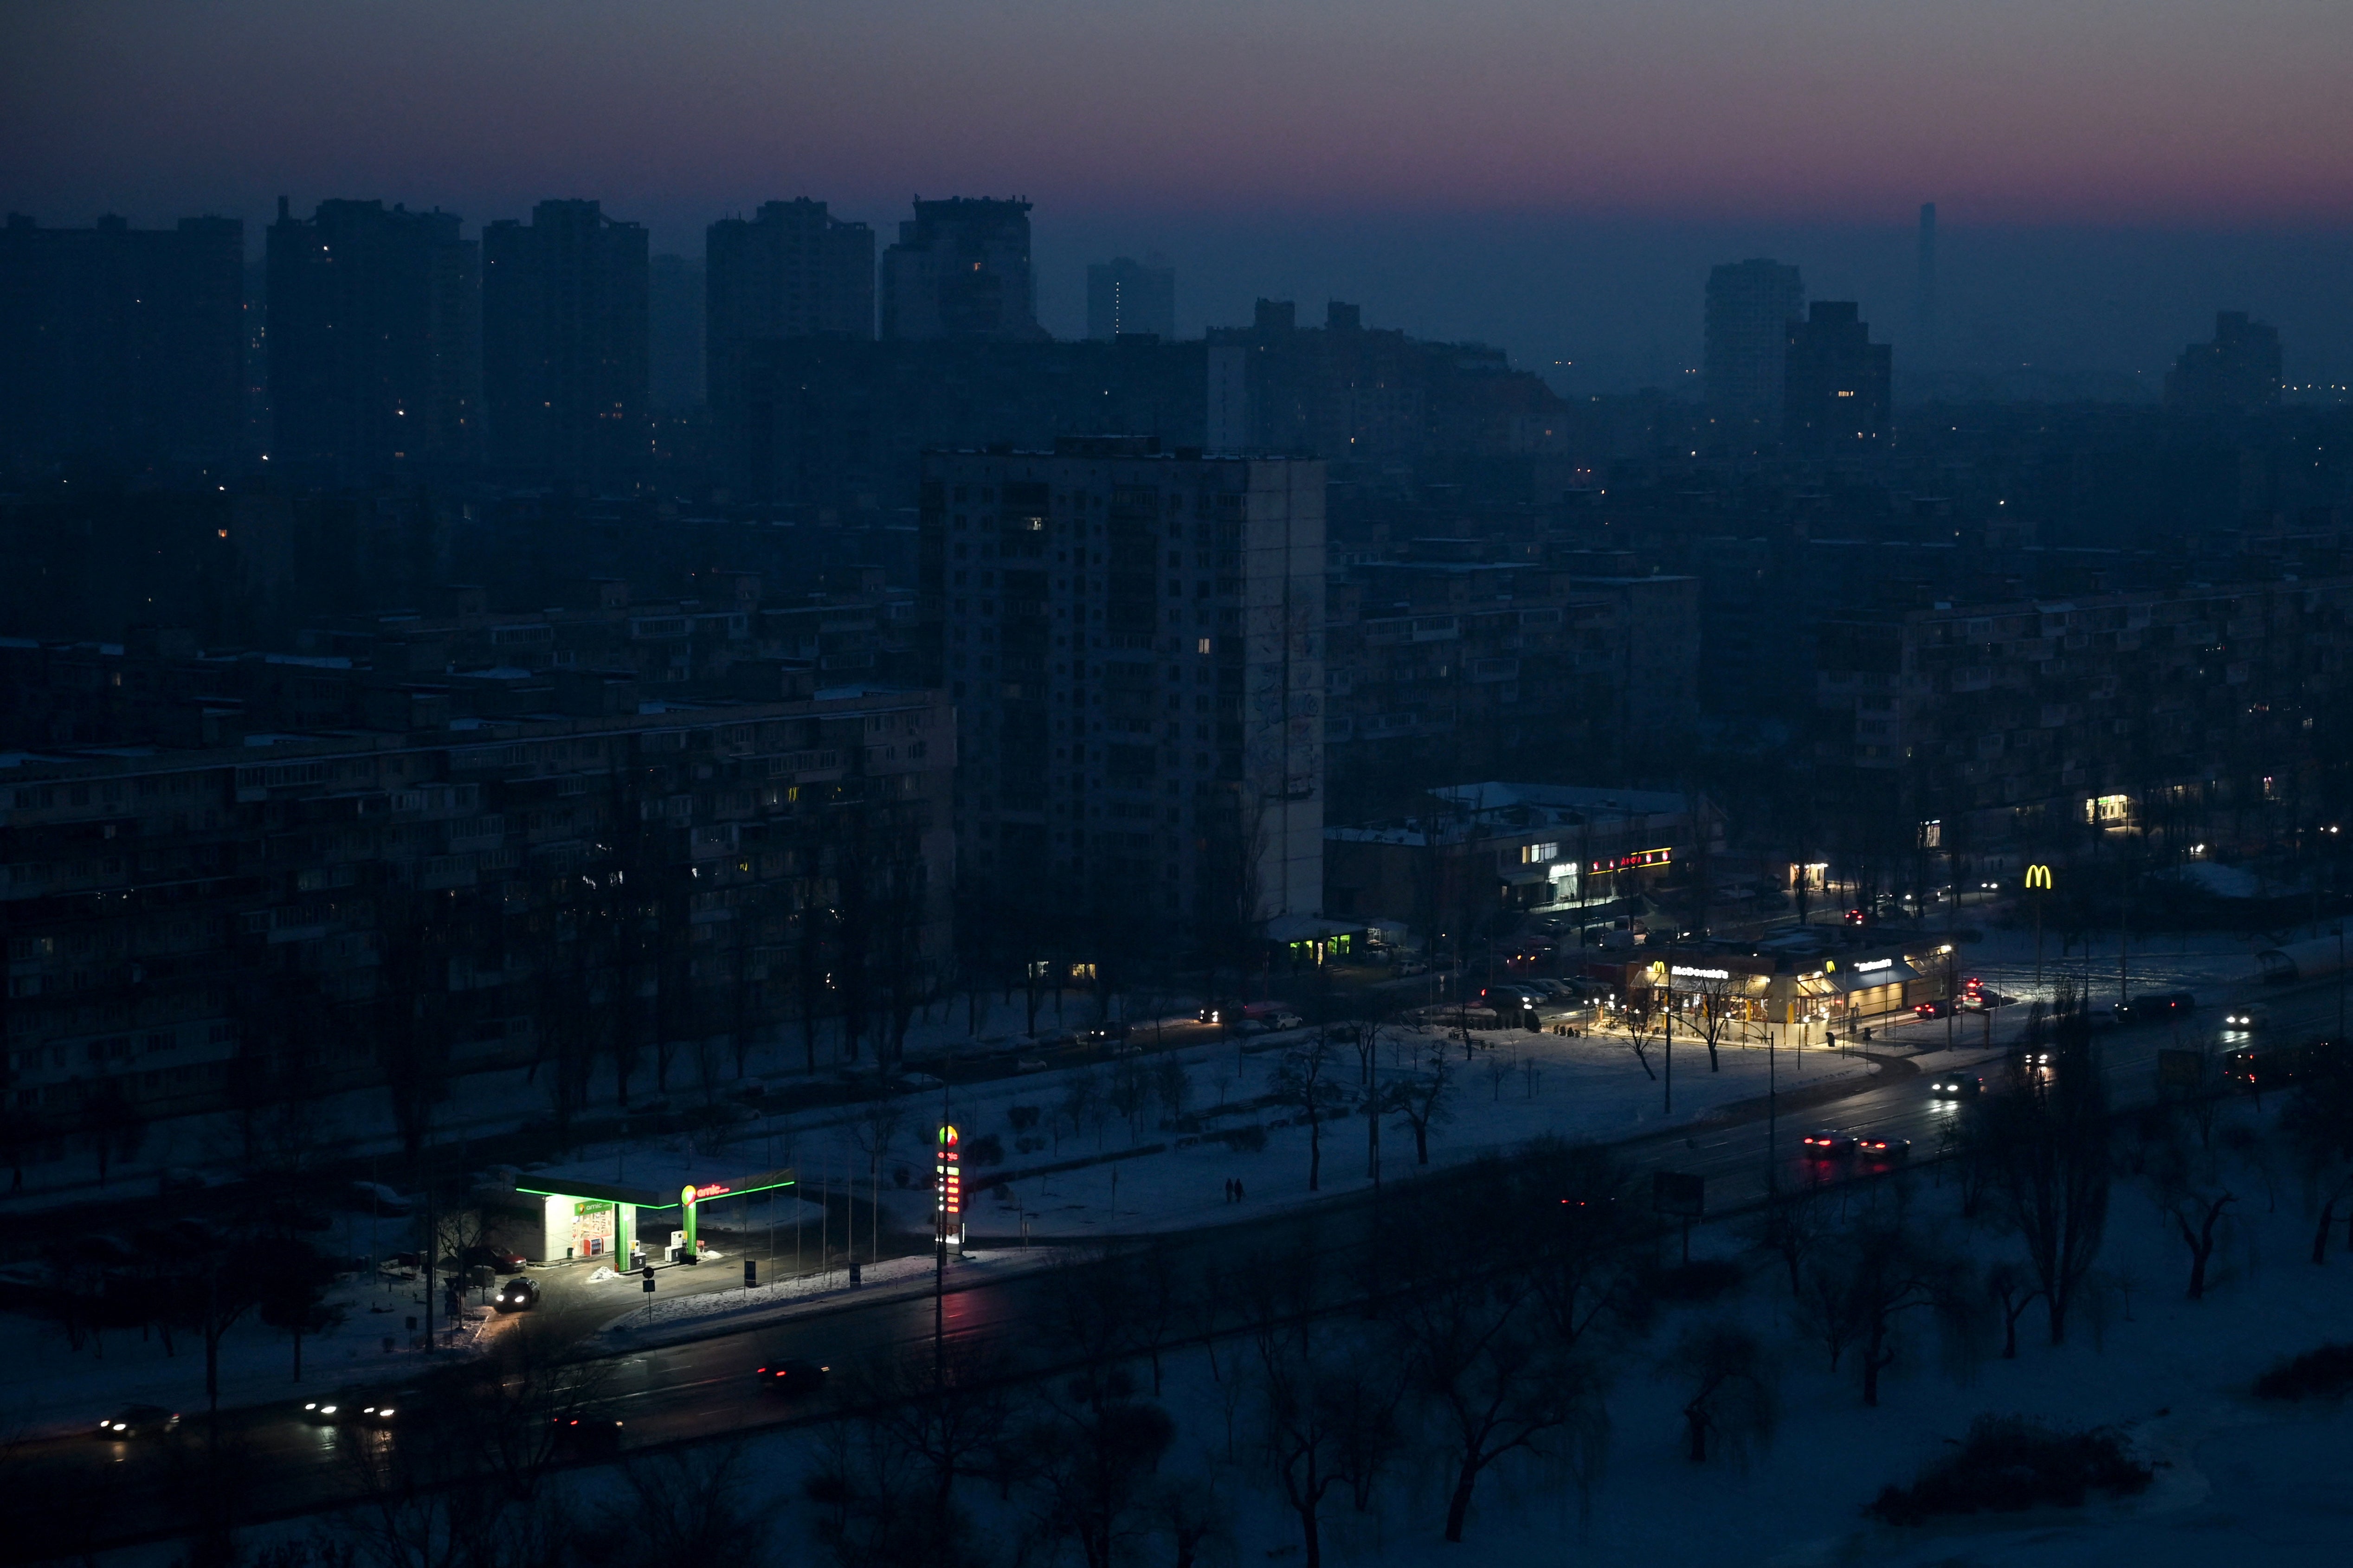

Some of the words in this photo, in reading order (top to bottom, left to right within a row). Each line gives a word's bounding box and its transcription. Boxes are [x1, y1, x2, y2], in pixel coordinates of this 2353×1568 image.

[2026, 864, 2051, 889] M
[1671, 965, 1728, 979] McDonald's
[696, 1184, 721, 1197] amic
